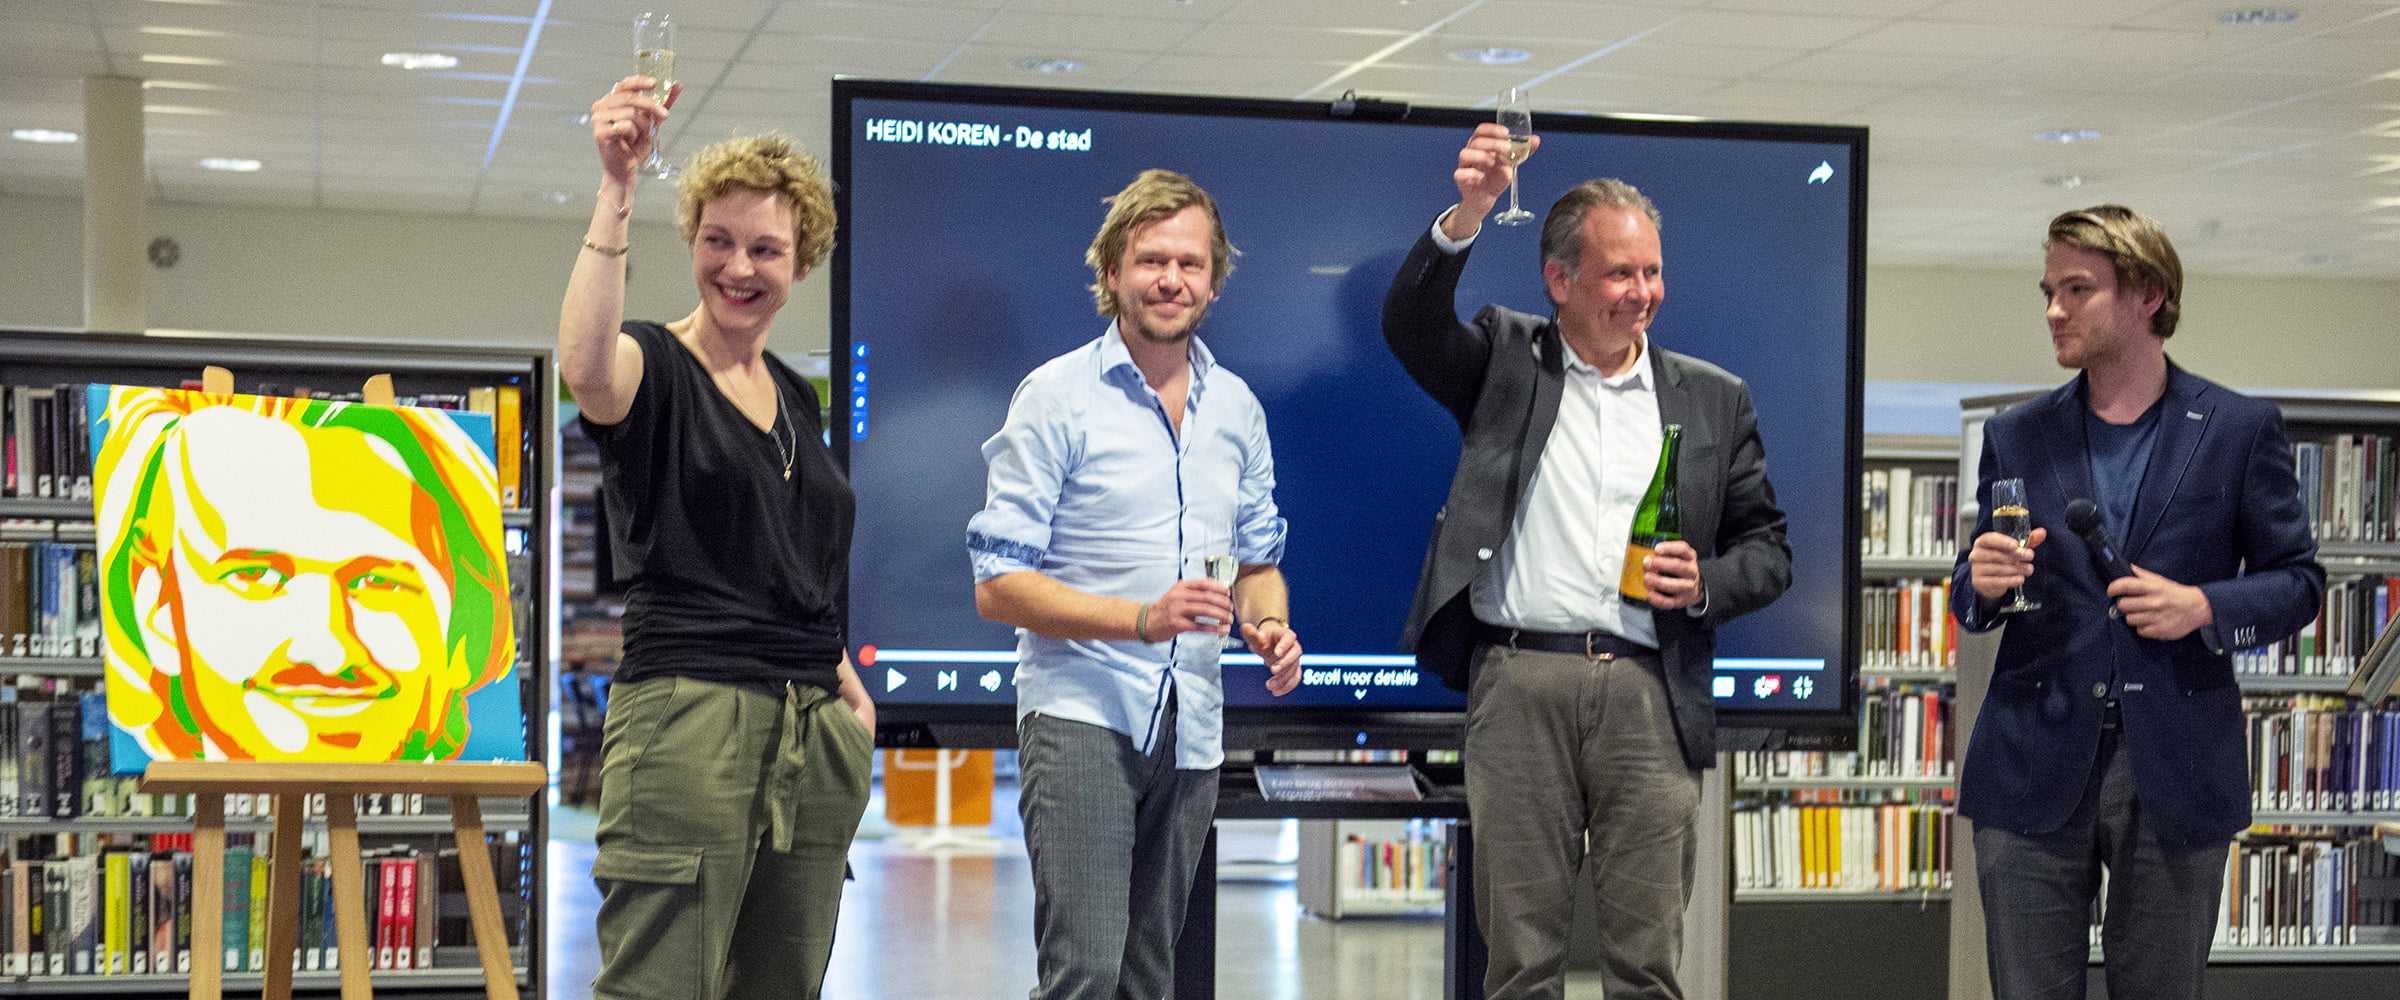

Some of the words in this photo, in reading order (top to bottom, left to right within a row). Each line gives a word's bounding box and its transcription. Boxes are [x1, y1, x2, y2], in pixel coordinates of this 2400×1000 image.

[866, 118, 924, 143] HEIDI
[927, 121, 1000, 147] KOREN
[1015, 126, 1044, 149] De
[1046, 128, 1092, 151] stad
[1303, 668, 1341, 686] Scroll
[1342, 671, 1374, 686] voor
[1374, 668, 1419, 687] details
